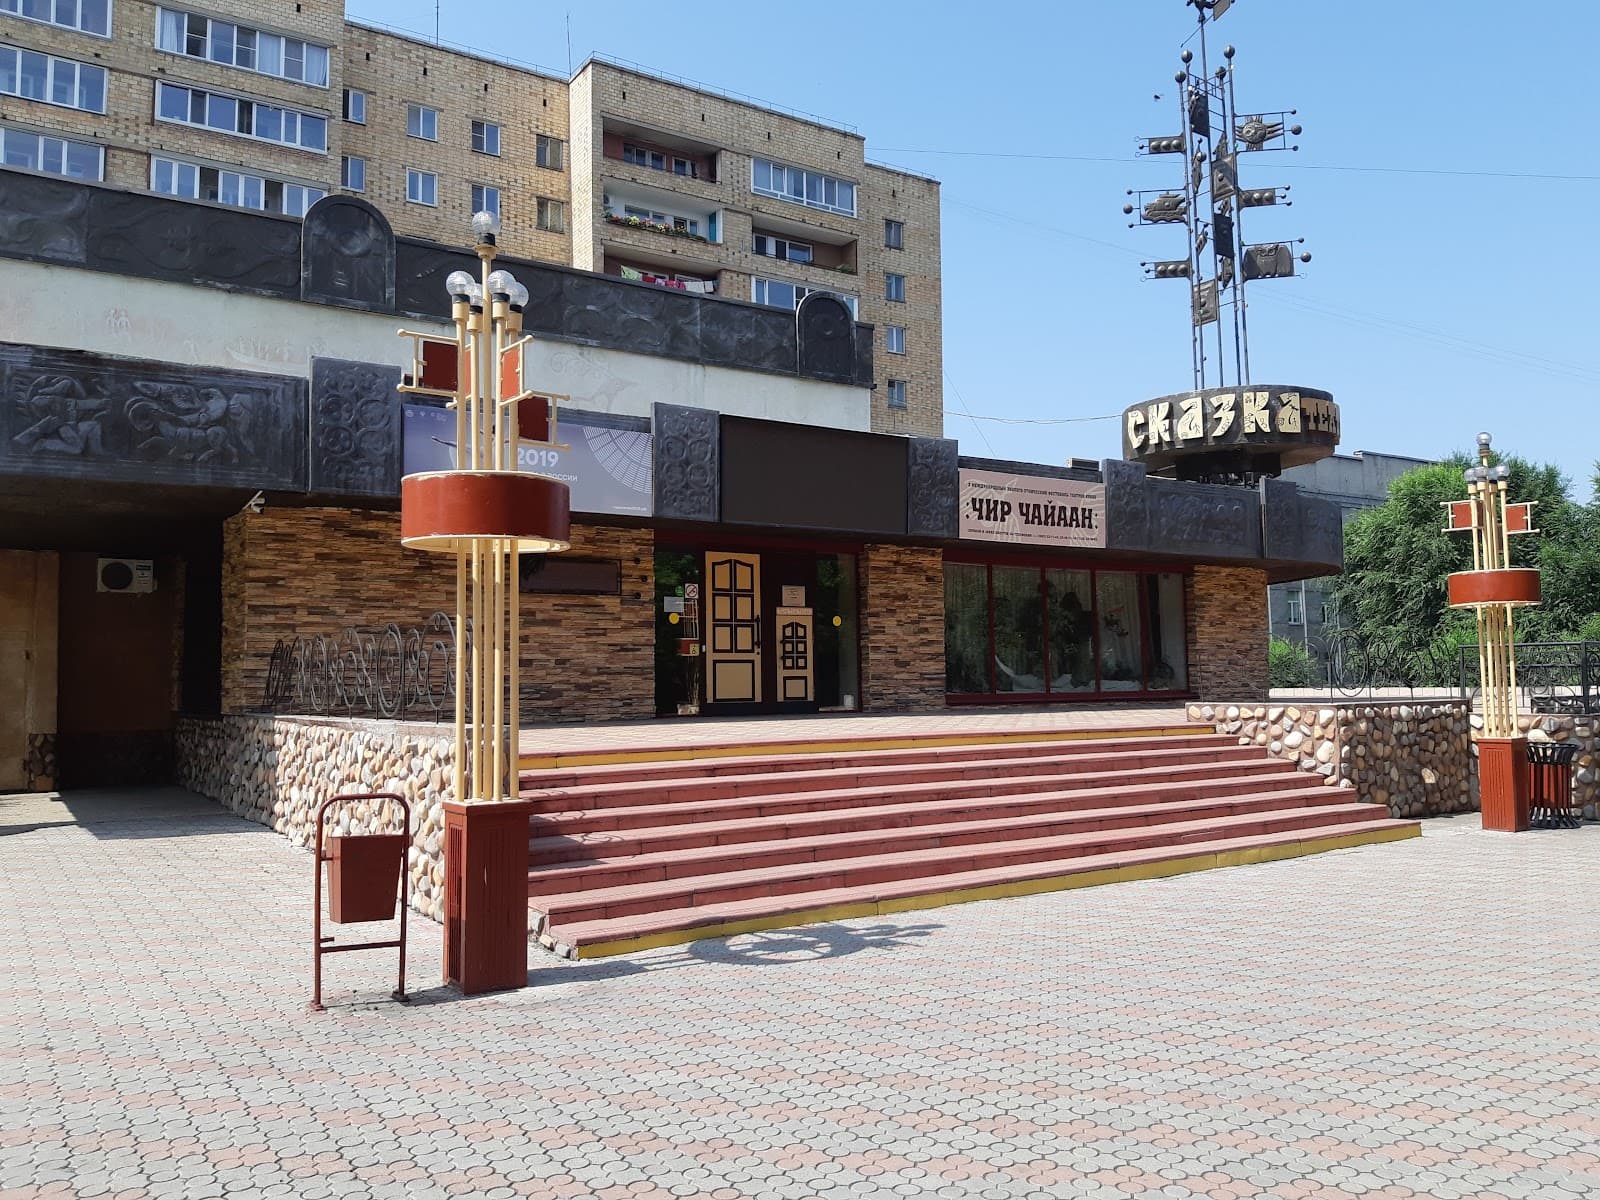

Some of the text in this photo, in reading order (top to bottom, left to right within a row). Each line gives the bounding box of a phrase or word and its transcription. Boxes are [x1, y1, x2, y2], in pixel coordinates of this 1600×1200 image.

[517, 447, 559, 467] 2019
[547, 471, 578, 481] ОССИИ
[971, 497, 1093, 529] ЧИР ЧАЙААН
